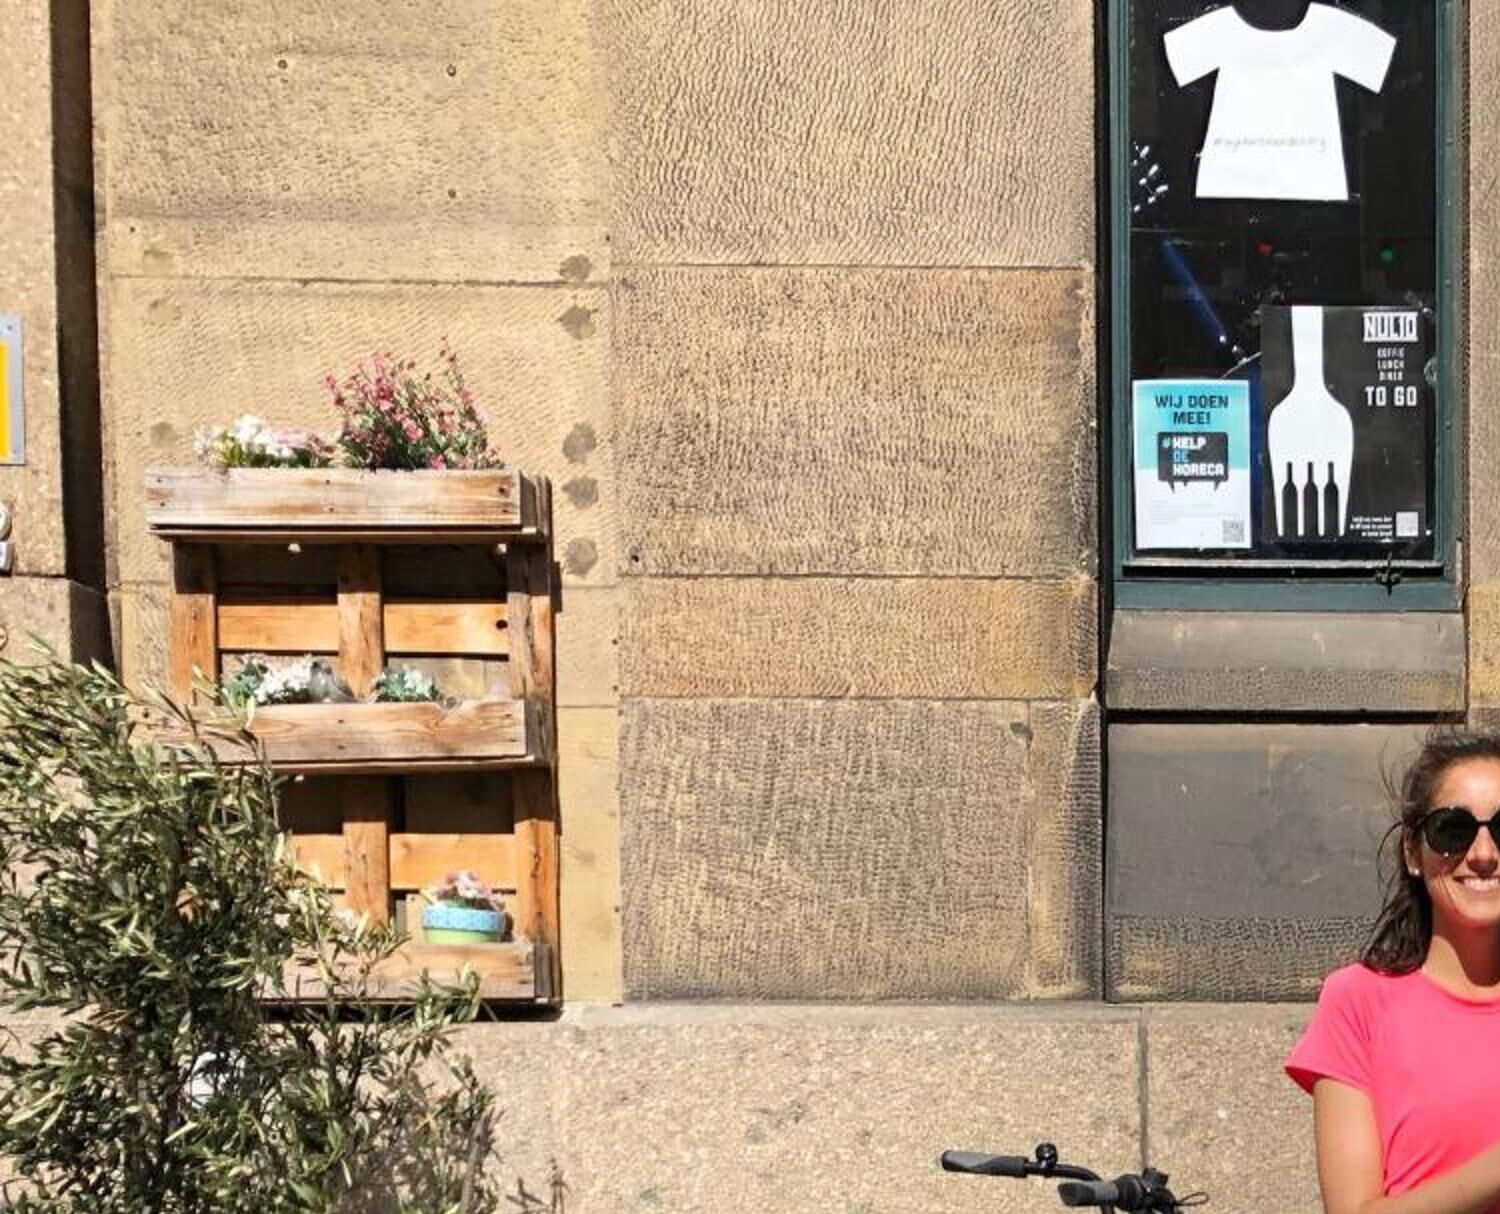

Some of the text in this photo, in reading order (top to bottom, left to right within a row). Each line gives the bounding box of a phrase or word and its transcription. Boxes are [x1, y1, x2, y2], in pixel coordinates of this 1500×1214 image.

[1377, 360, 1405, 370] LUNCH
[1379, 371, 1403, 381] DINER
[1155, 395, 1229, 408] WIJ DOEN
[1365, 386, 1417, 407] TO GO
[1173, 411, 1212, 425] MEE!
[1173, 450, 1190, 462] DE
[1173, 463, 1225, 476] HORECA
